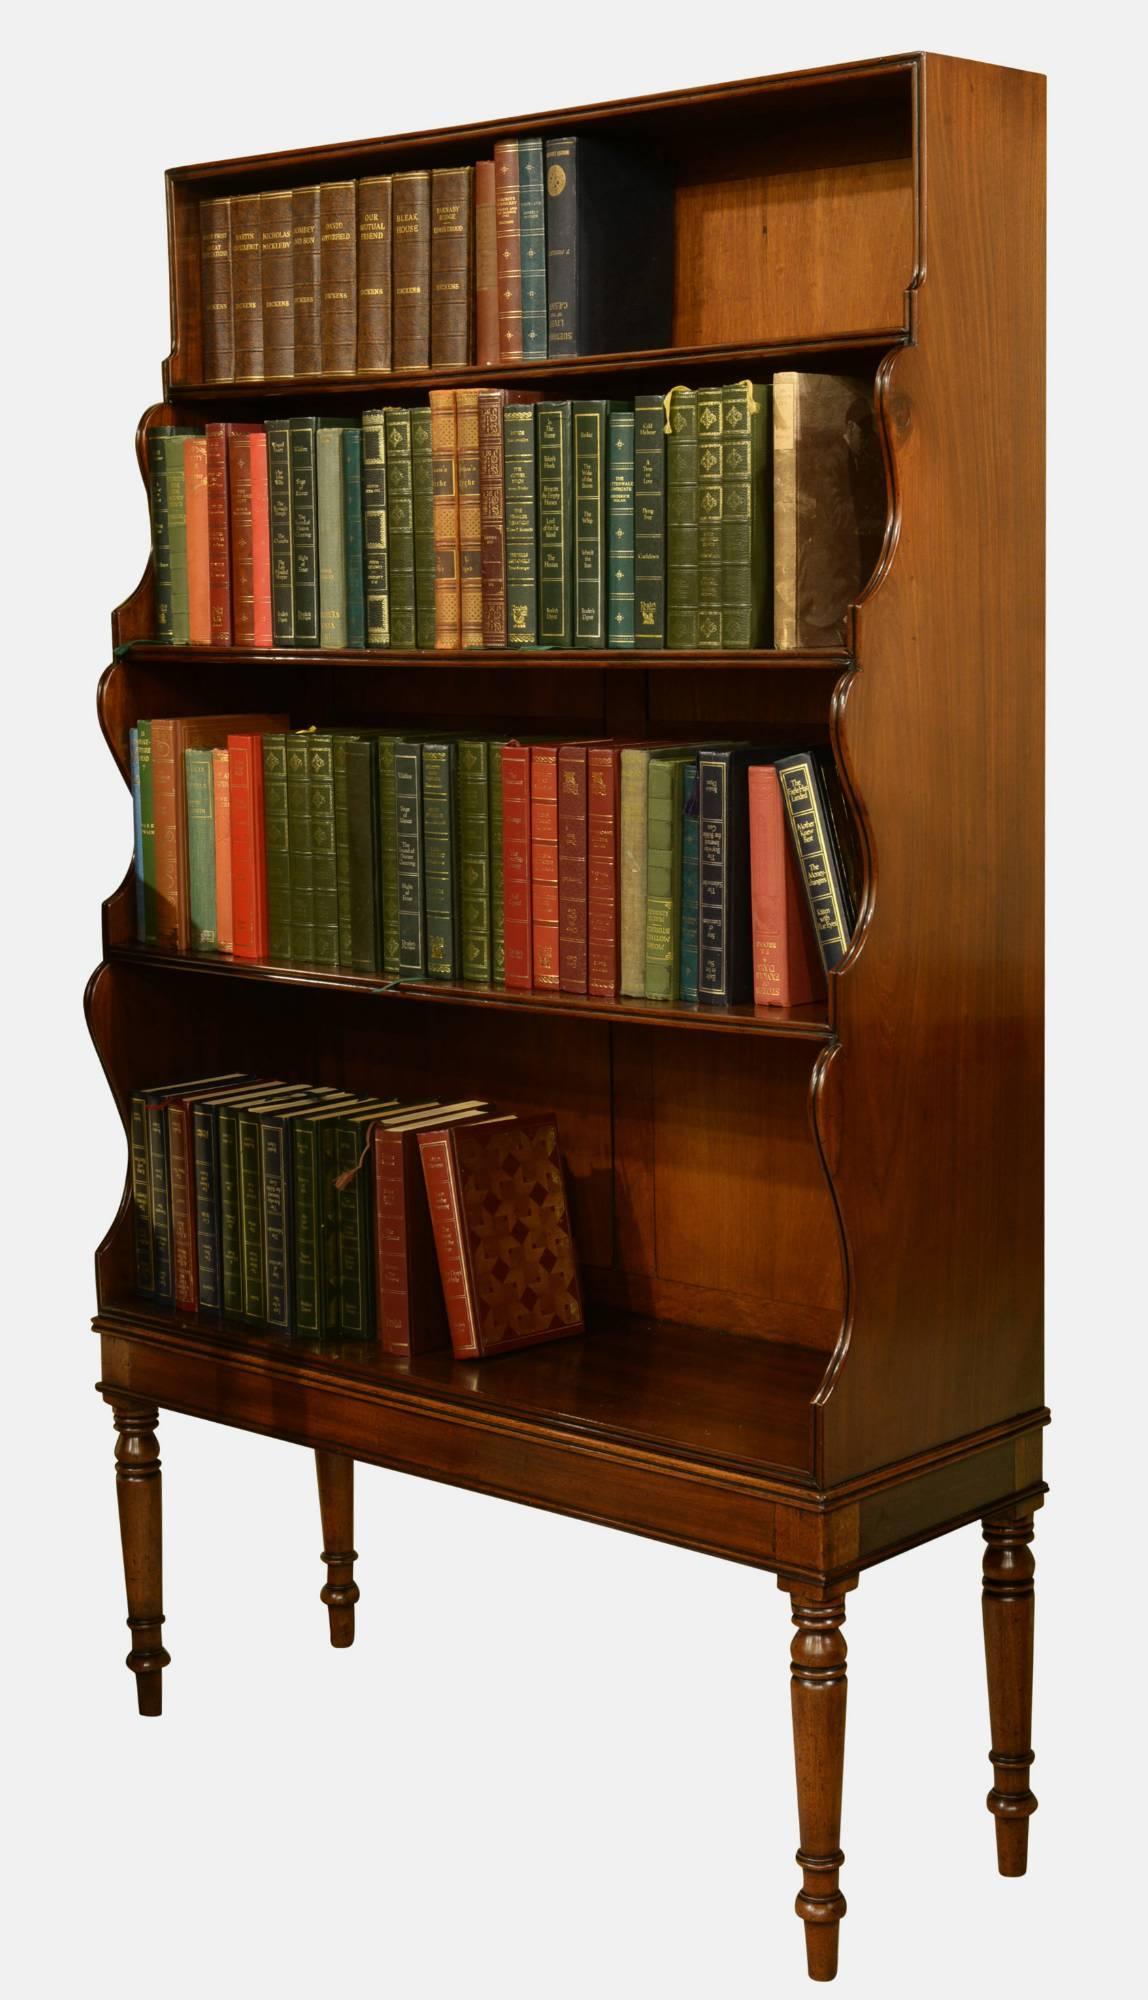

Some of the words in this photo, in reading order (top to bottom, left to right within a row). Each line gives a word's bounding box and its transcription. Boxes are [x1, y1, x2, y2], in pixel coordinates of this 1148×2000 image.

[364, 213, 379, 222] OUR
[396, 213, 418, 222] BLEAK
[396, 224, 419, 234] HOUSE
[262, 231, 291, 240] NICHOLAS
[360, 232, 384, 241] FRIEND
[791, 779, 801, 787] The
[808, 863, 820, 872] The
